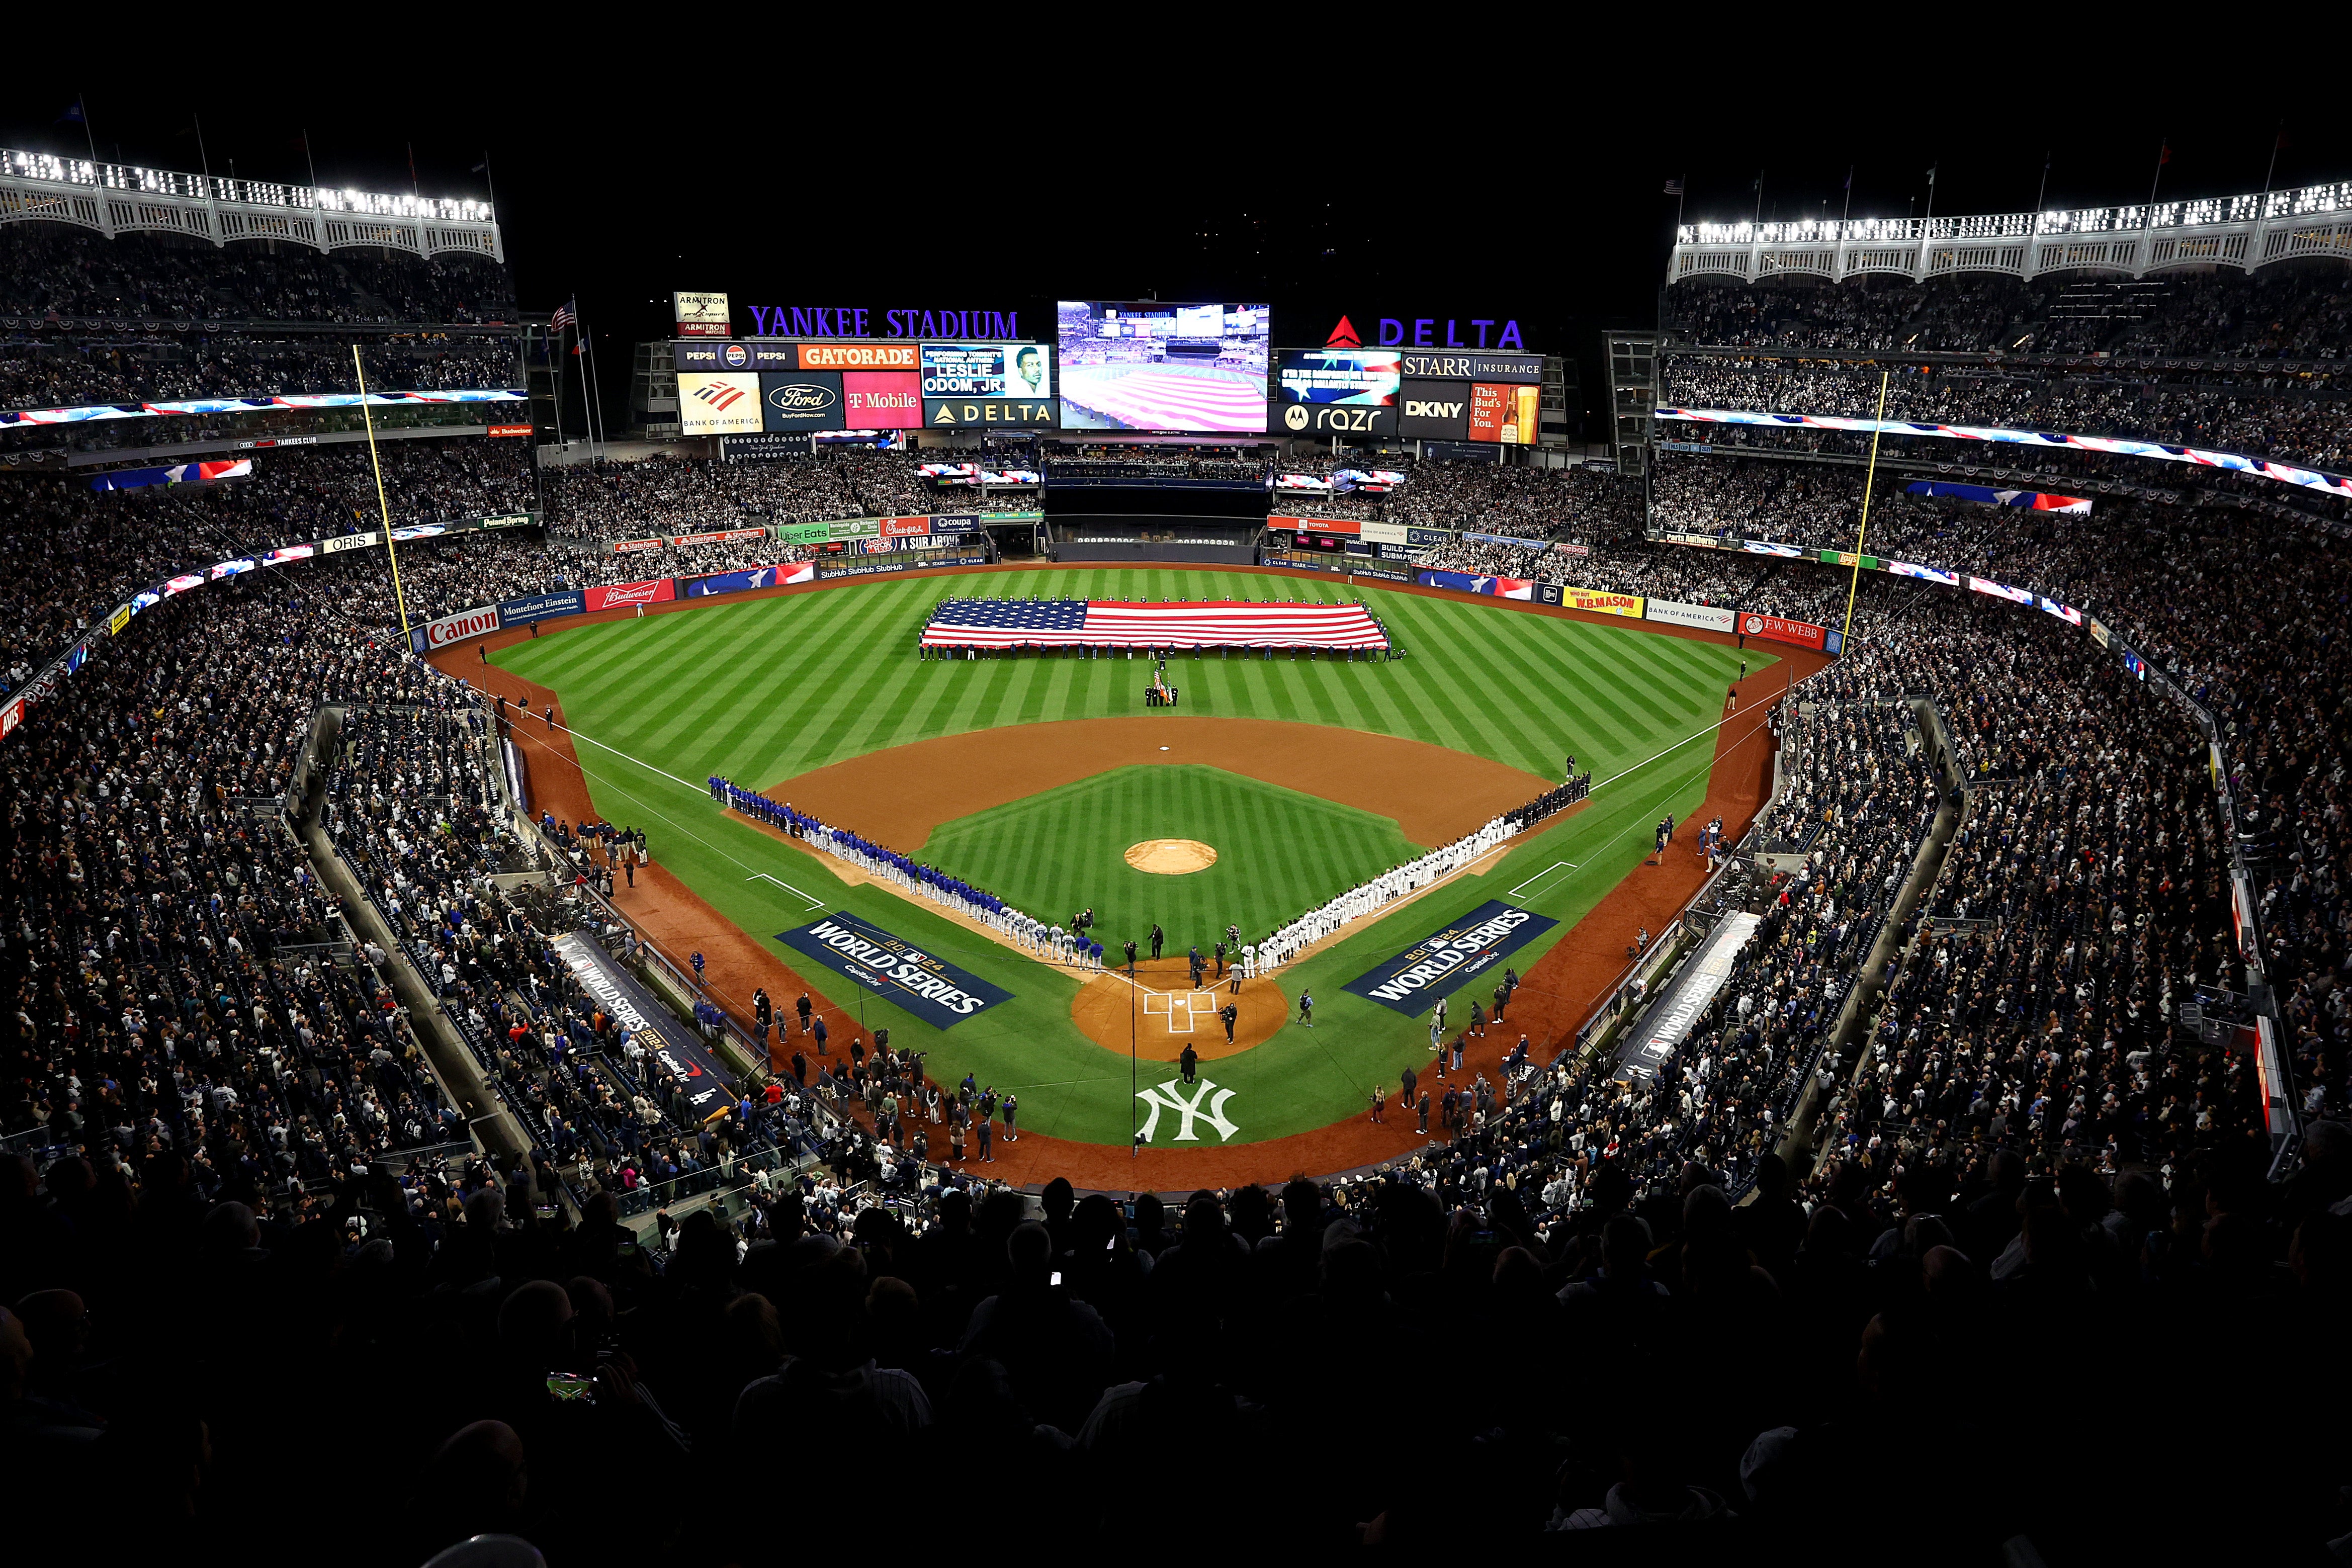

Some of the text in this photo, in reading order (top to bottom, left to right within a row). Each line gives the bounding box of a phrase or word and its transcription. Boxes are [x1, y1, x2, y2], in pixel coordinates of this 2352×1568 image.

[748, 305, 1018, 340] YANKEE STADIUM
[1379, 318, 1523, 349] DELTA
[686, 352, 716, 360] PEPSI
[757, 352, 785, 360] PEPSI
[806, 348, 914, 365] GATORADE
[936, 364, 993, 377] LESLIE
[1404, 357, 1471, 376] STARR
[1477, 365, 1539, 374] INSURANCE
[924, 378, 1005, 393] ODOM, JR.
[1475, 387, 1497, 397] This
[781, 388, 824, 406] Ford
[866, 392, 917, 408] Mobile
[1474, 397, 1501, 407] Bud's
[964, 405, 1051, 421] DELTA
[1405, 401, 1463, 418] DKNY
[1474, 408, 1490, 417] For
[1317, 408, 1381, 431] razr
[1473, 418, 1494, 427] You.
[484, 516, 529, 528] Poland Spring
[948, 518, 971, 527] coupa
[805, 529, 827, 538] Eats
[1667, 534, 1685, 542] Parts
[1685, 535, 1718, 546] Authority
[333, 535, 366, 550] ORIS
[864, 537, 892, 547] Jersey
[900, 538, 906, 550] A
[910, 537, 929, 550] SUB
[1381, 544, 1404, 552] BUILD
[1556, 544, 1588, 554] Reebok
[1840, 554, 1857, 565] Lay's
[821, 568, 846, 579] StubHub
[848, 566, 874, 575] StubHub
[876, 564, 903, 572] StubHub
[1353, 569, 1371, 577] StubHub
[1372, 571, 1390, 579] StubHub
[606, 589, 654, 602] Budweiser
[503, 596, 577, 616] Montefiore Einstein
[1681, 613, 1714, 622] AMERICA
[429, 612, 497, 644] Canon
[1765, 619, 1784, 632] F.W.
[1787, 623, 1817, 639] WEBB
[1828, 638, 1840, 647] YORK
[3, 706, 19, 736] AVIS
[1440, 929, 1459, 941] 24
[883, 939, 906, 952] 20
[1368, 909, 1530, 1002] WORLD SERIES
[1405, 949, 1426, 961] 20
[808, 921, 985, 1014] WORLD SERIES
[922, 959, 945, 971] 24
[1707, 957, 1725, 975] 2024
[580, 966, 651, 1032] WORLD SERIES
[1658, 973, 1717, 1041] WORLD SERIES
[640, 1029, 665, 1050] 2024
[689, 1087, 717, 1105] LA
[1135, 1078, 1240, 1143] NY
